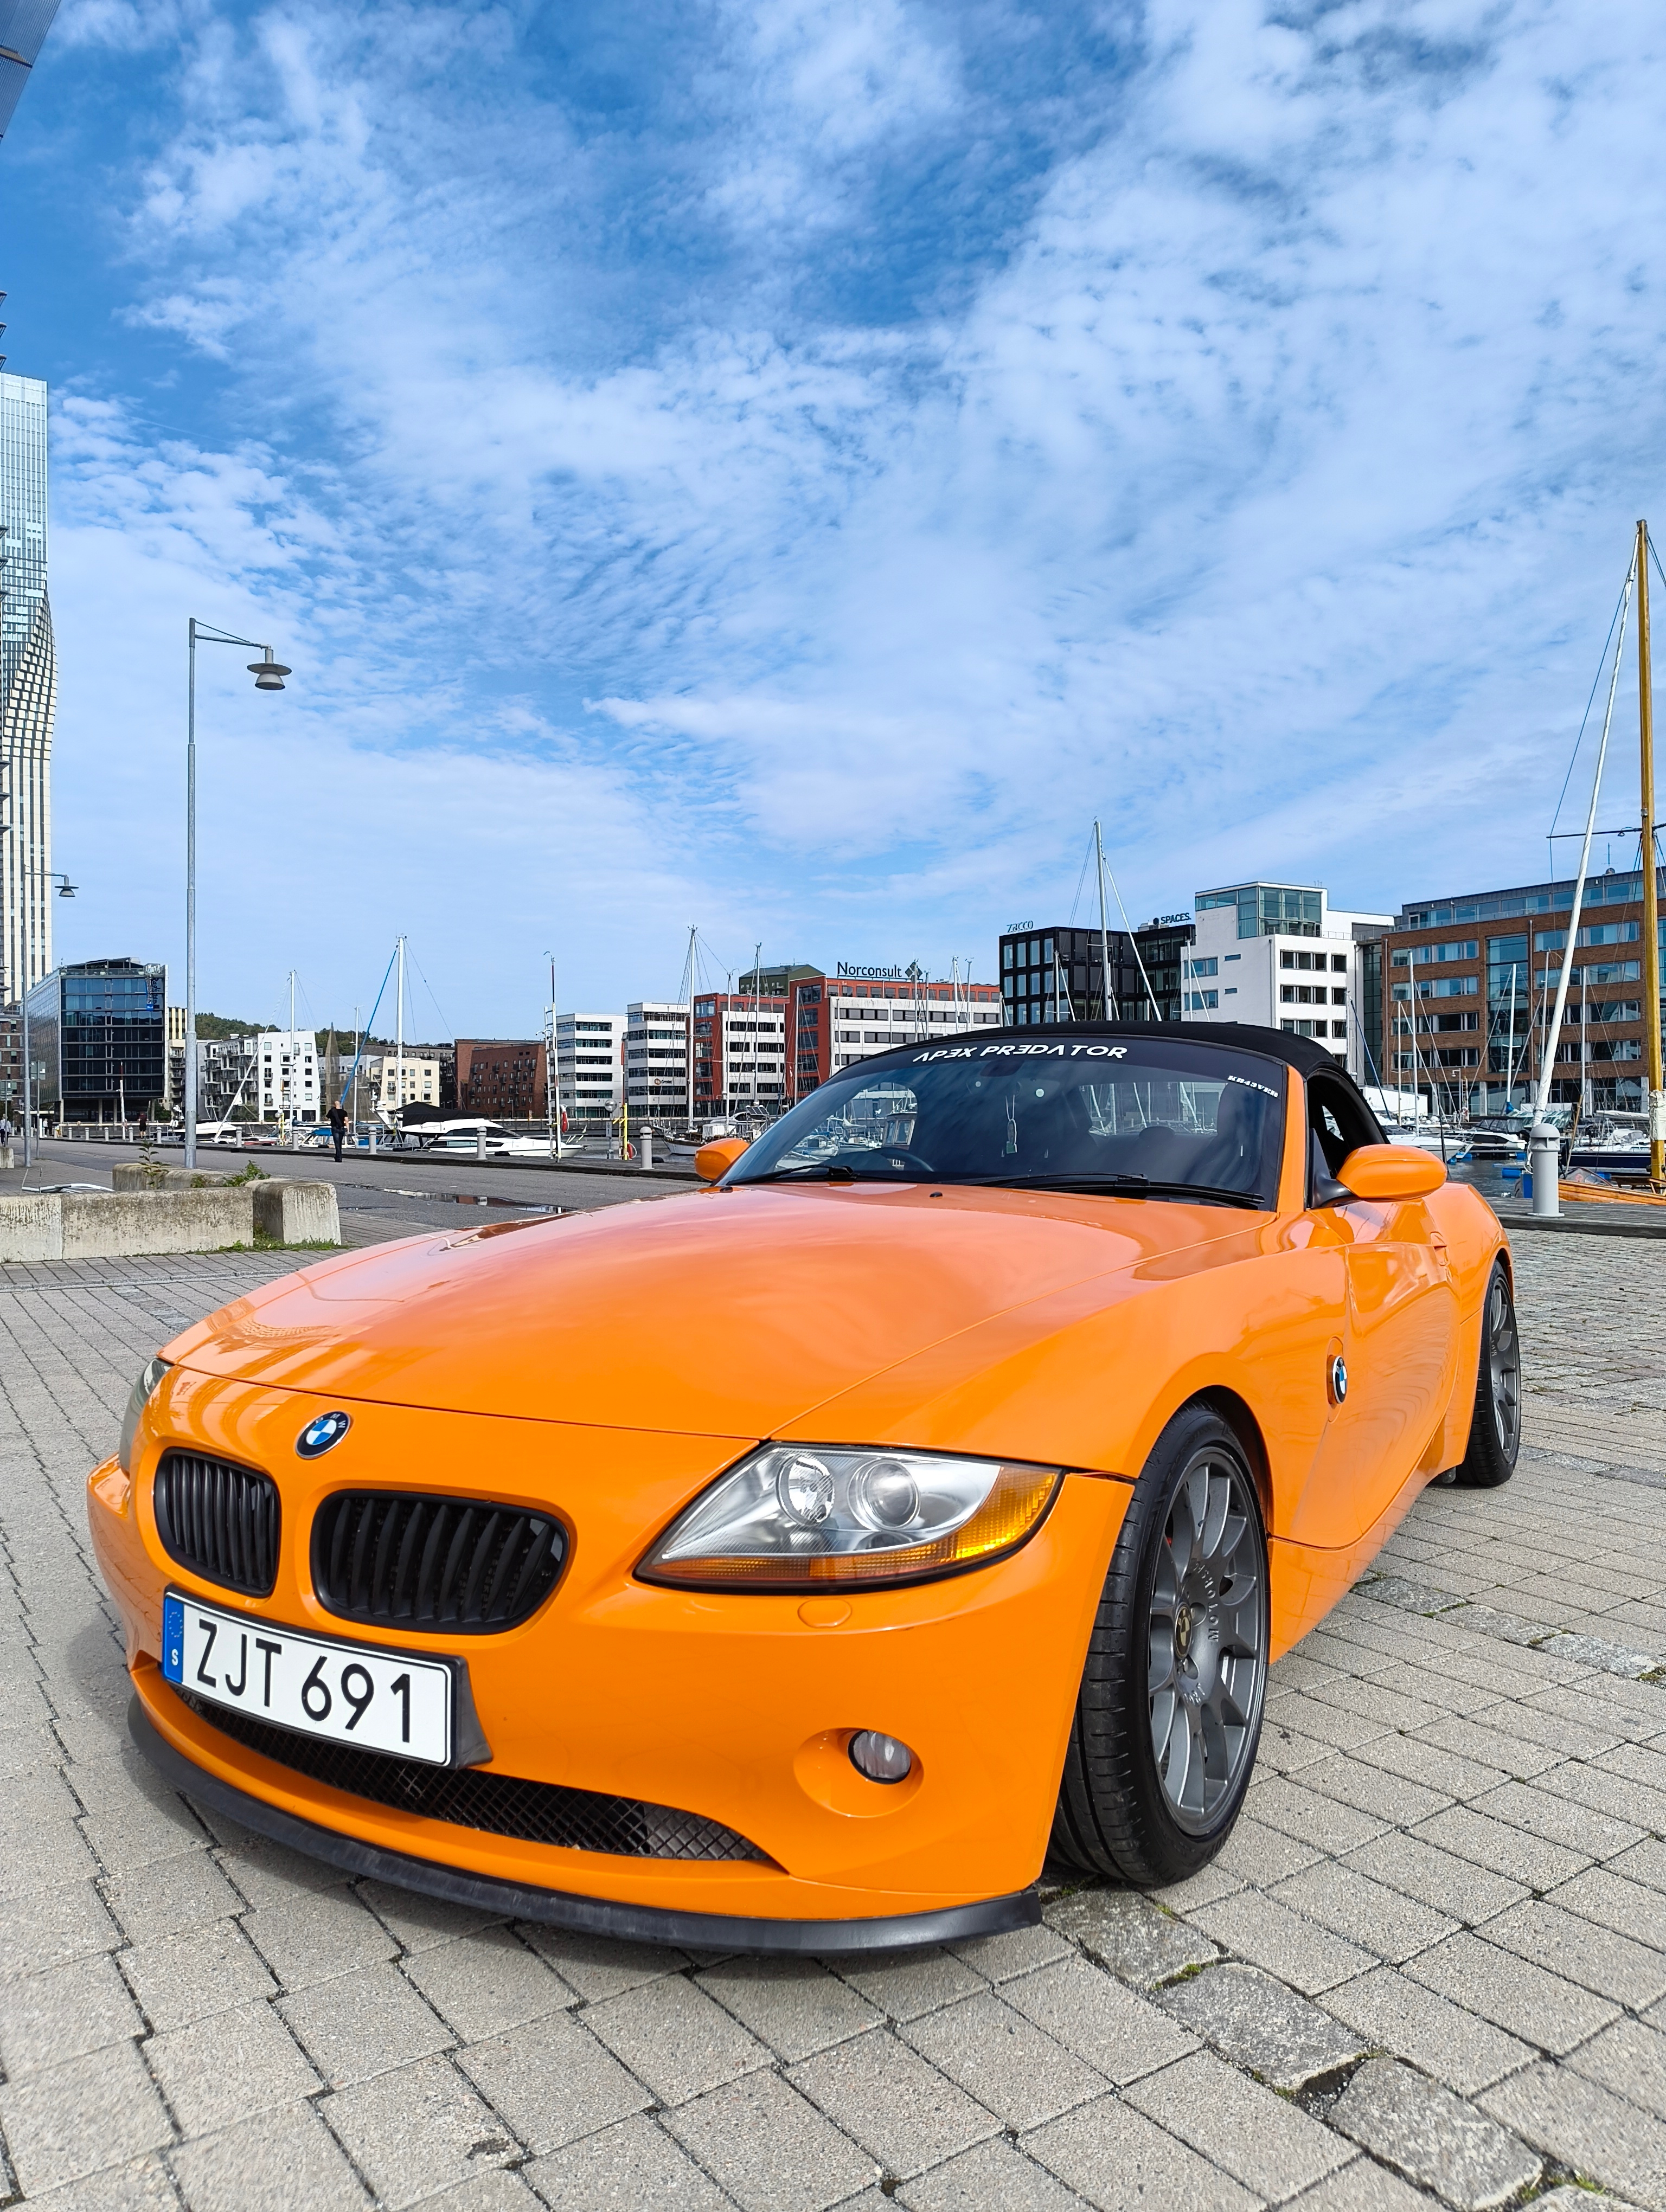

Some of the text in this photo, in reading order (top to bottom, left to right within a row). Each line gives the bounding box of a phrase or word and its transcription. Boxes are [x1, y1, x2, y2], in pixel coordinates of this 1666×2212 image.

[837, 961, 902, 978] Norconsult
[315, 1413, 347, 1428] BMW
[171, 1649, 179, 1666] S
[197, 1618, 411, 1744] ZJT 691
